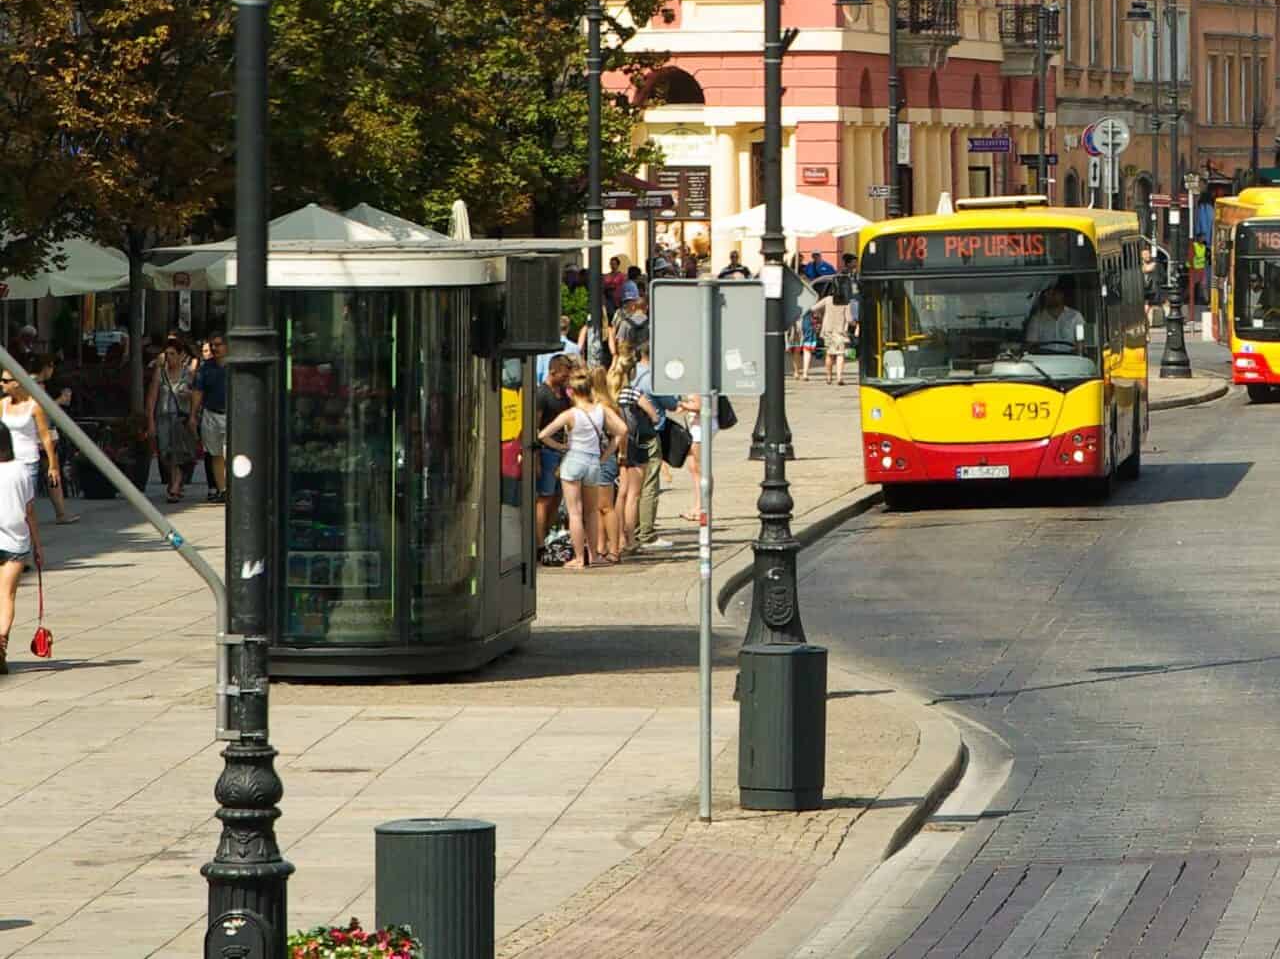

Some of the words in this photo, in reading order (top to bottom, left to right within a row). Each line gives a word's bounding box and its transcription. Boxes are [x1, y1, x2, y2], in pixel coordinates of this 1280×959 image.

[896, 236, 928, 261] 178
[944, 235, 982, 258] PKP
[984, 233, 1045, 257] URSUS
[1256, 232, 1280, 249] 116
[1003, 401, 1051, 421] 4795
